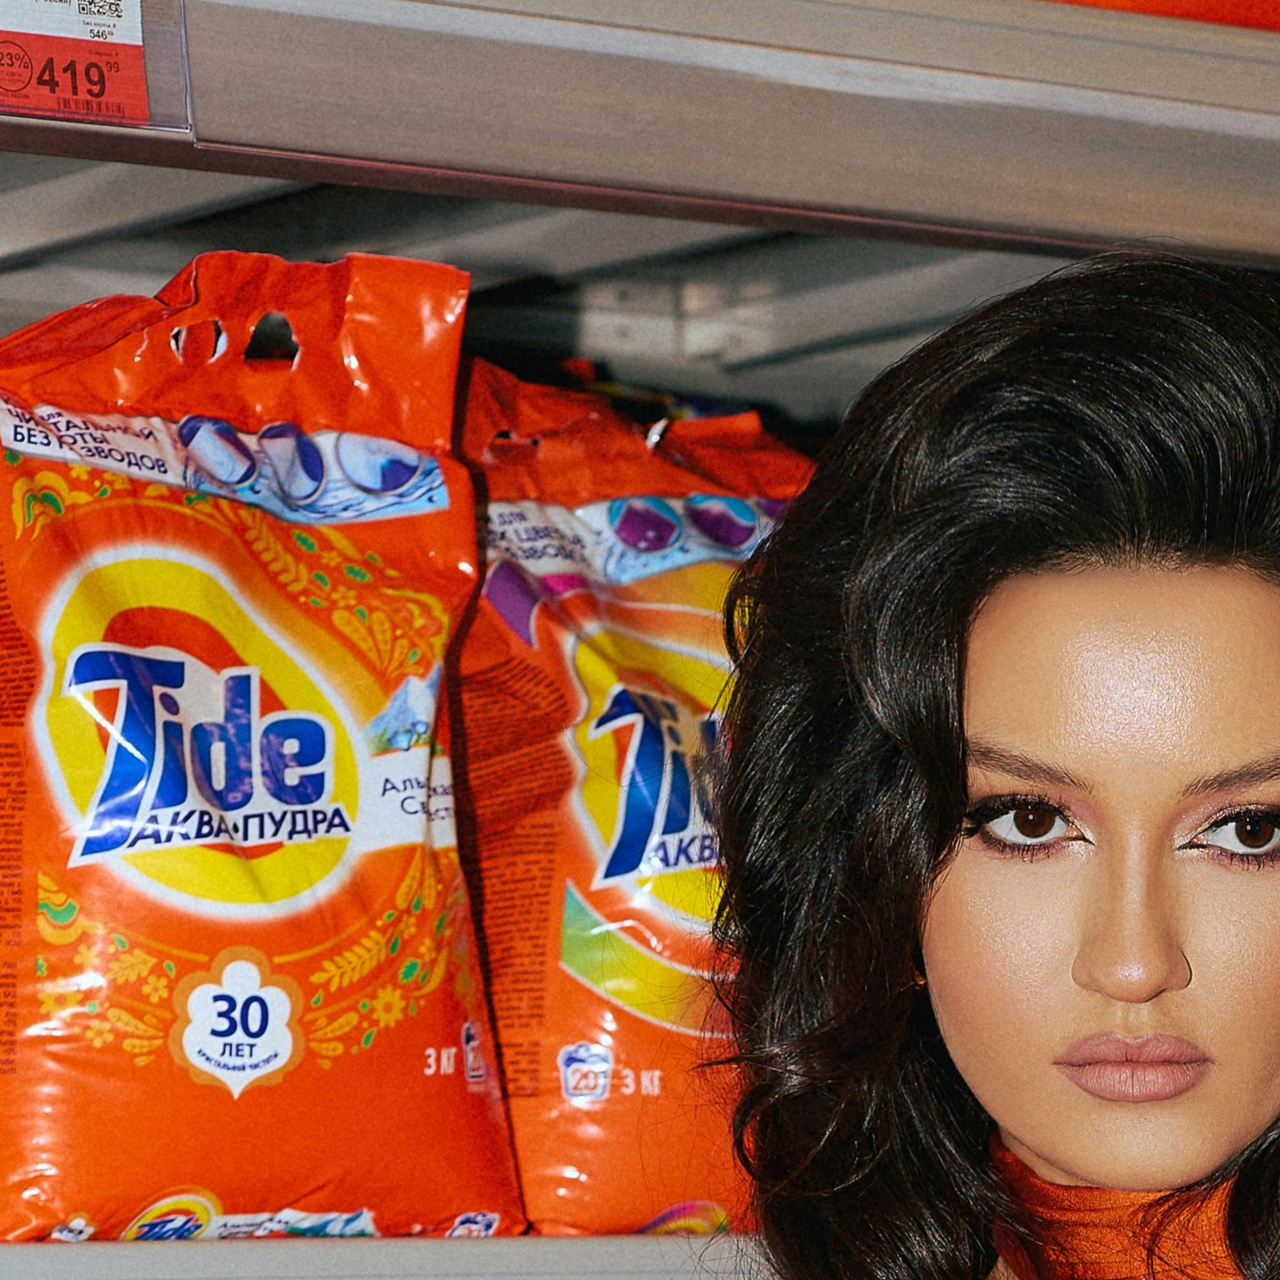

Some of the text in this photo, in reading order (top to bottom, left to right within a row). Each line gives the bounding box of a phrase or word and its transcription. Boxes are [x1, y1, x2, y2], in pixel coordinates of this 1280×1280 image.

[90, 29, 108, 40] 546
[36, 57, 106, 99] 419
[13, 425, 52, 446] БЕЗ
[69, 650, 328, 858] Tide
[210, 994, 270, 1039] 30
[220, 1042, 258, 1058] ЛЕТ
[620, 1070, 635, 1095] 3
